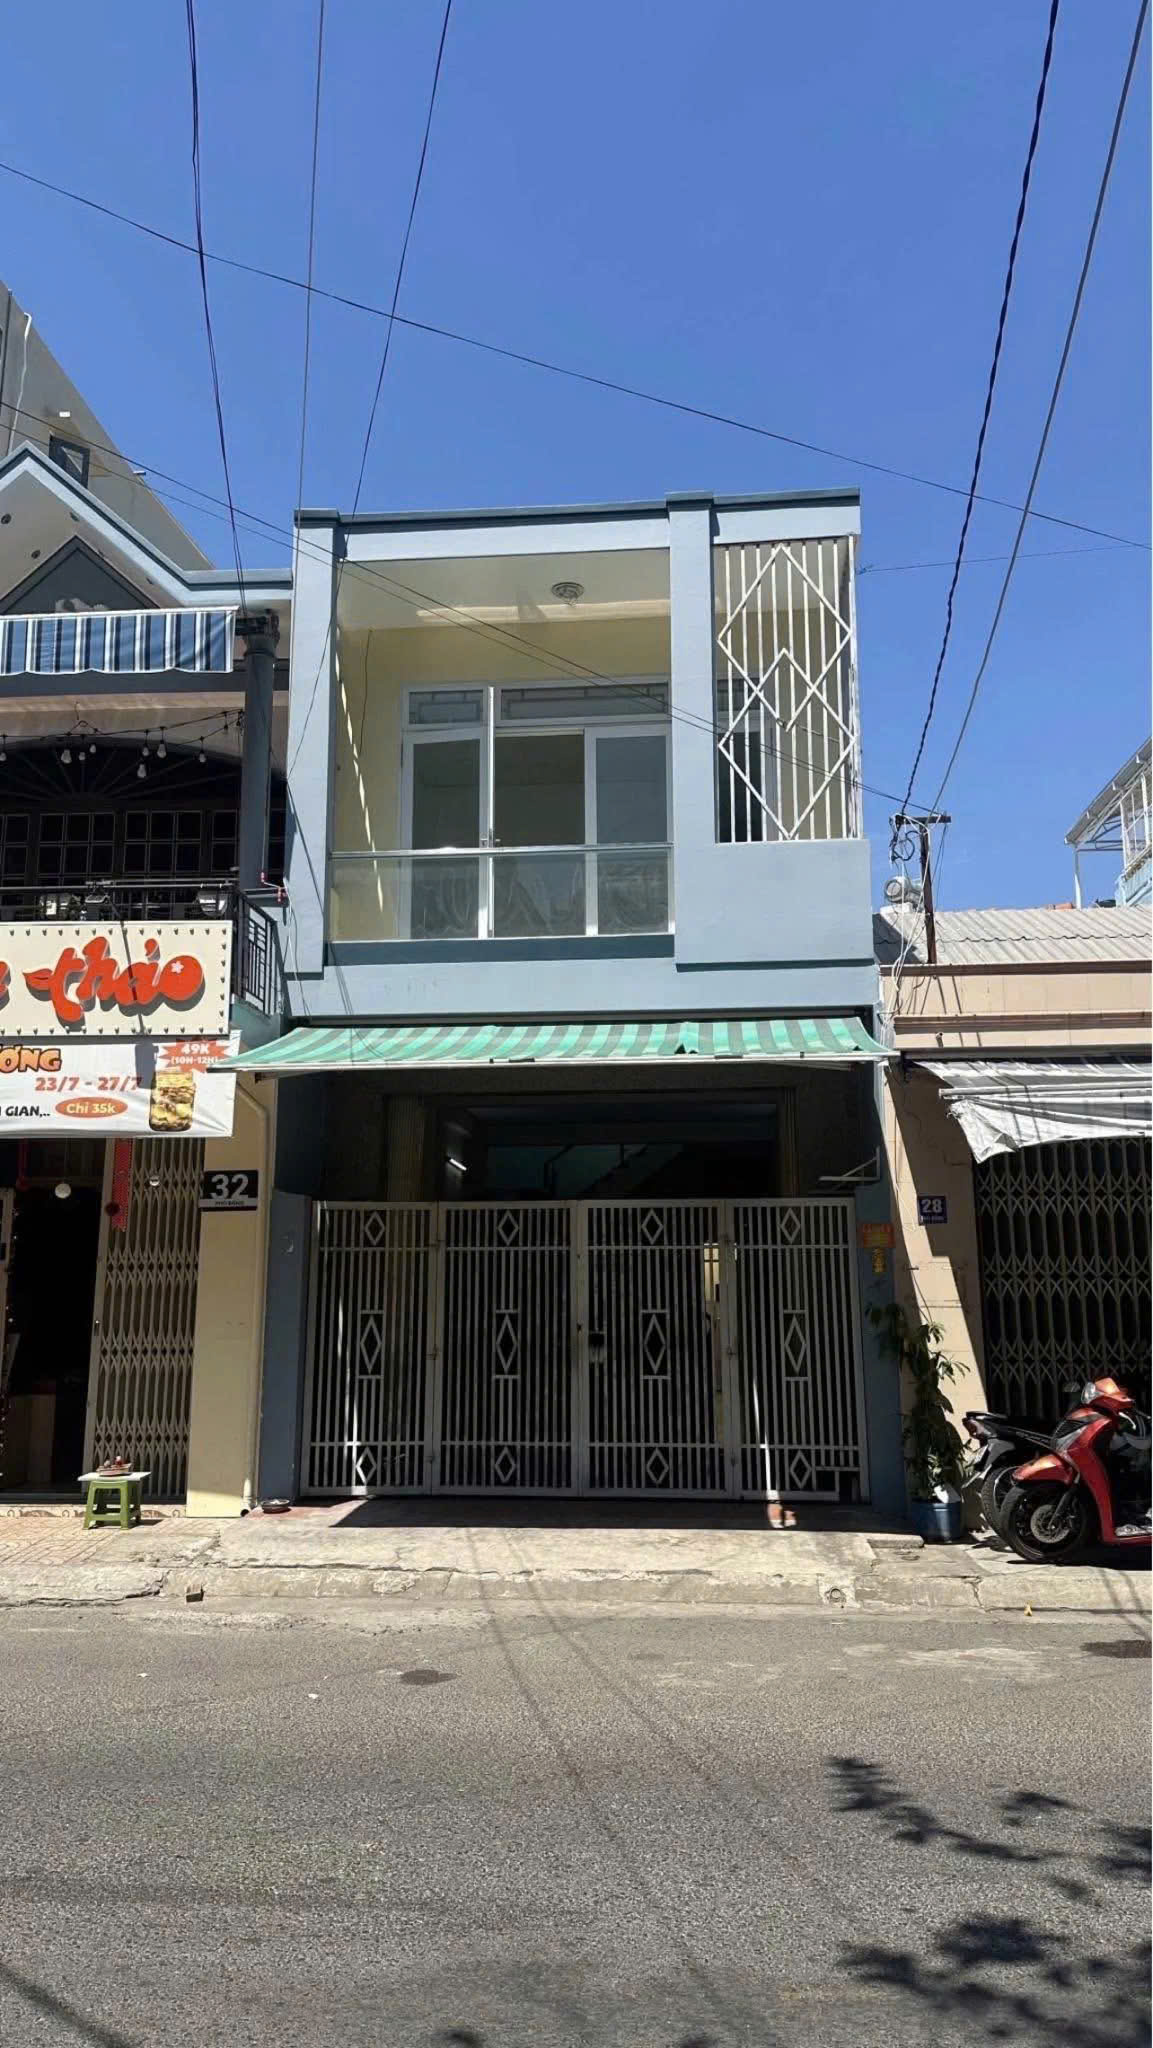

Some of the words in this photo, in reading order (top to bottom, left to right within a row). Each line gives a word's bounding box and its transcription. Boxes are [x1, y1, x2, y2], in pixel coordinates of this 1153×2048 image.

[181, 1043, 209, 1055] 49K
[35, 1076, 80, 1092] 23/7
[97, 1076, 143, 1092] 27/7
[91, 1102, 116, 1114] 35k
[211, 1174, 249, 1200] 32
[921, 1199, 942, 1213] 28
